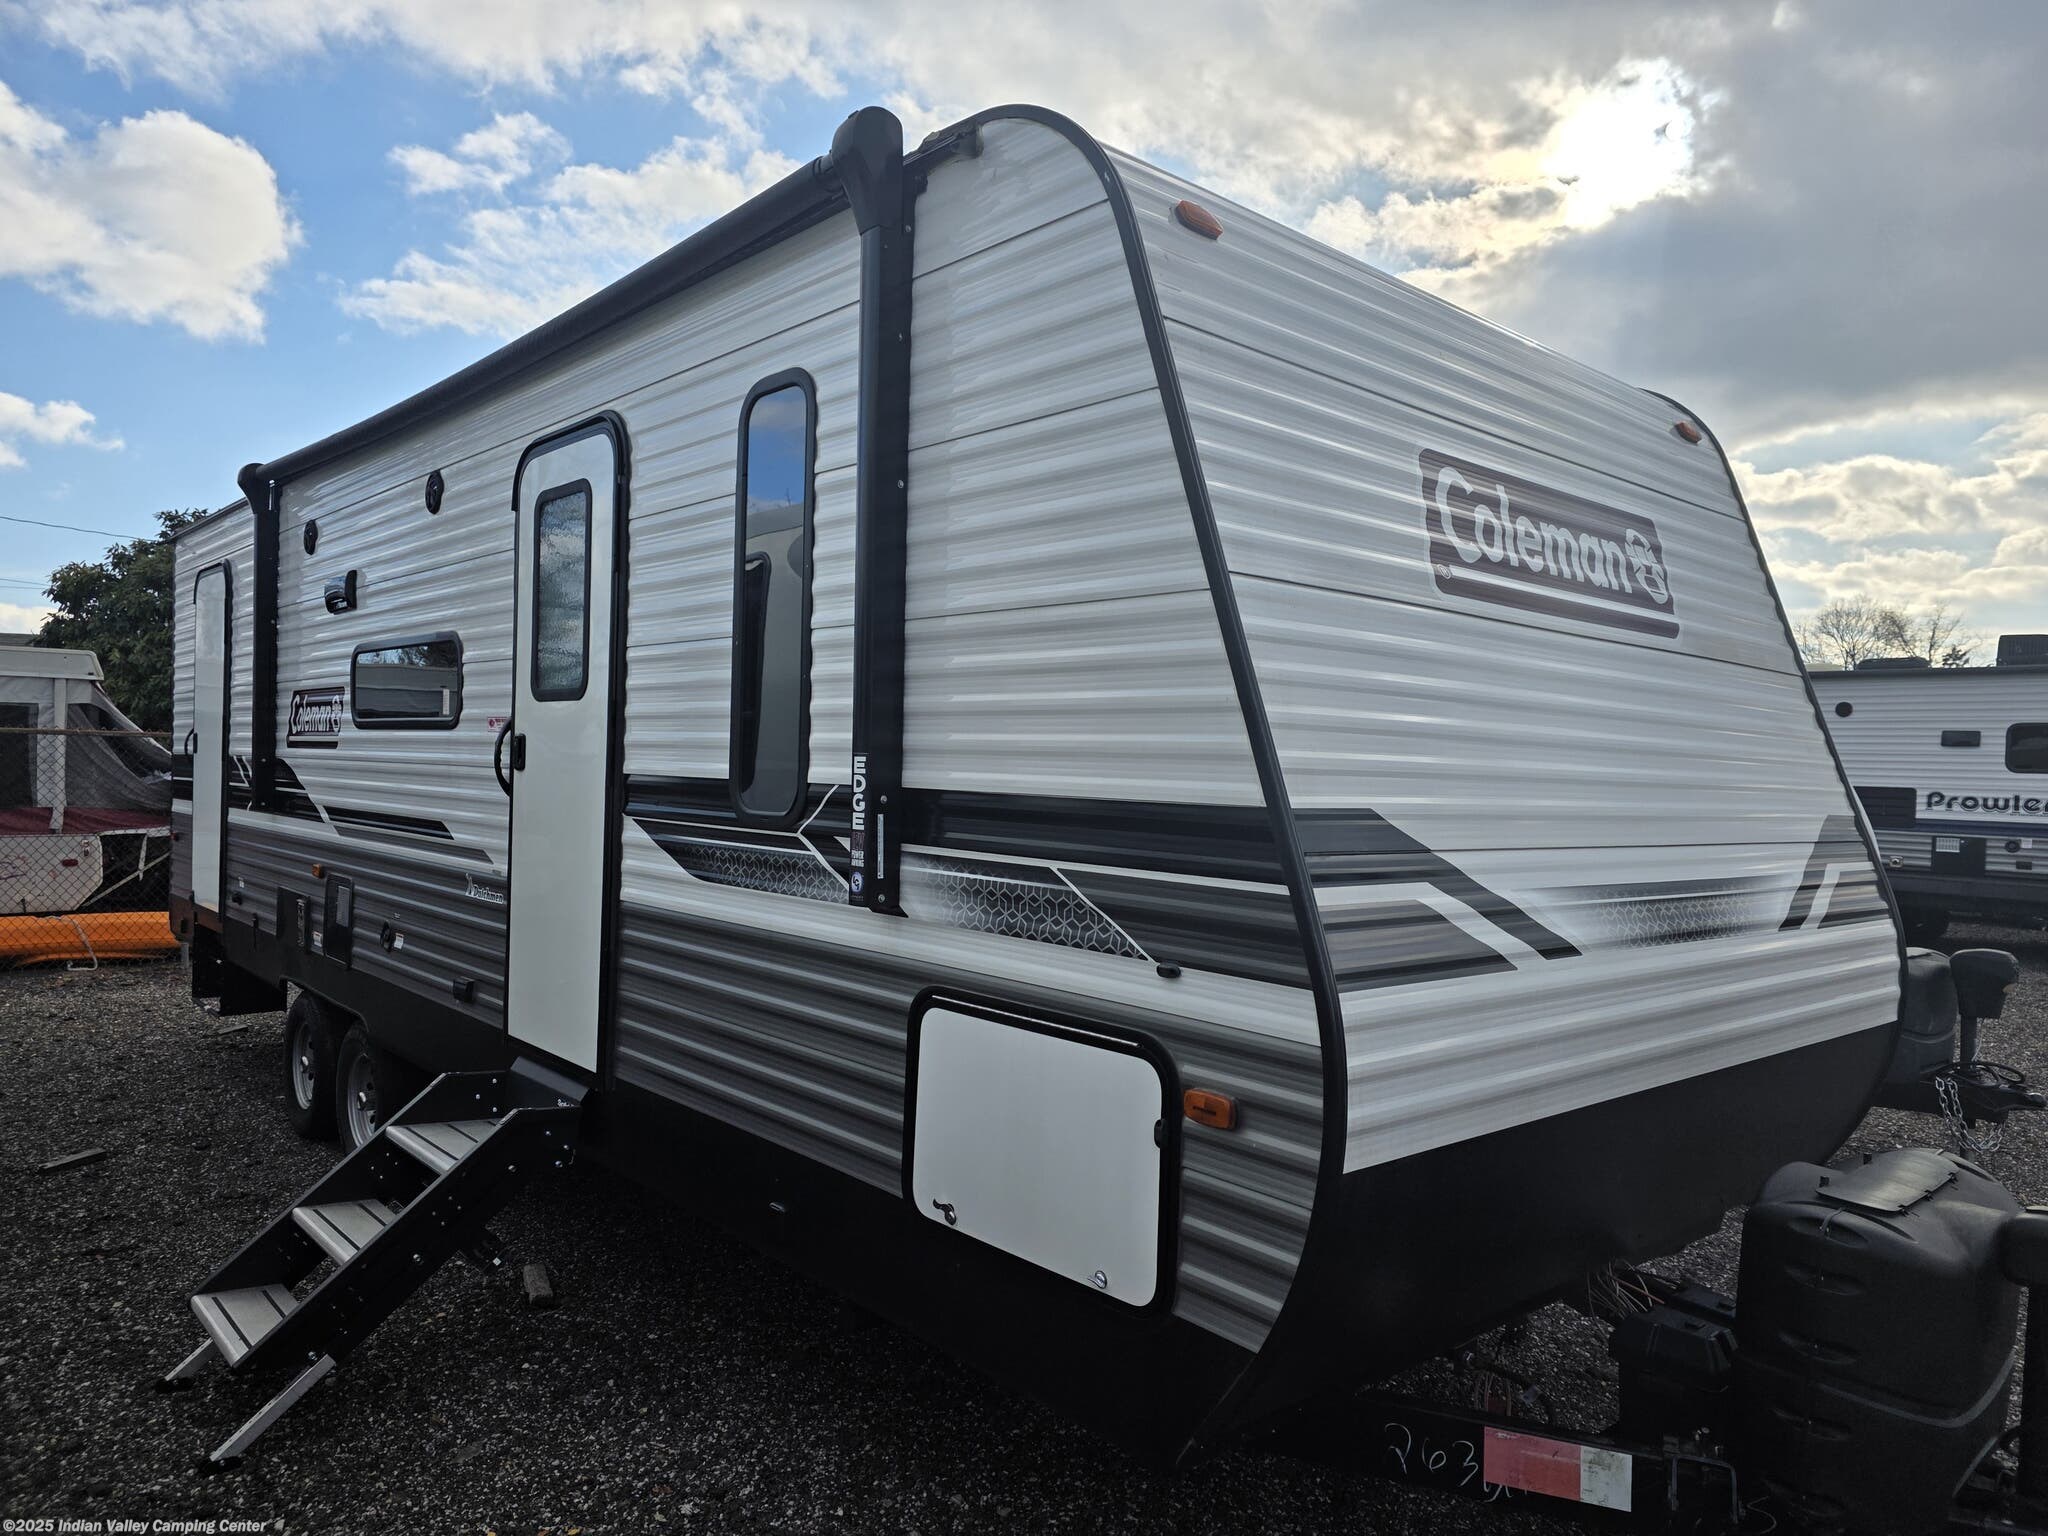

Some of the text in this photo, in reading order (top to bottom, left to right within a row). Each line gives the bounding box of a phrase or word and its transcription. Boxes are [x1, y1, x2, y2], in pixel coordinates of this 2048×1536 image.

[1435, 466, 1633, 594] Coleman
[291, 694, 331, 734] Coleman
[852, 756, 867, 831] EDGE
[1926, 791, 2048, 814] Prowle
